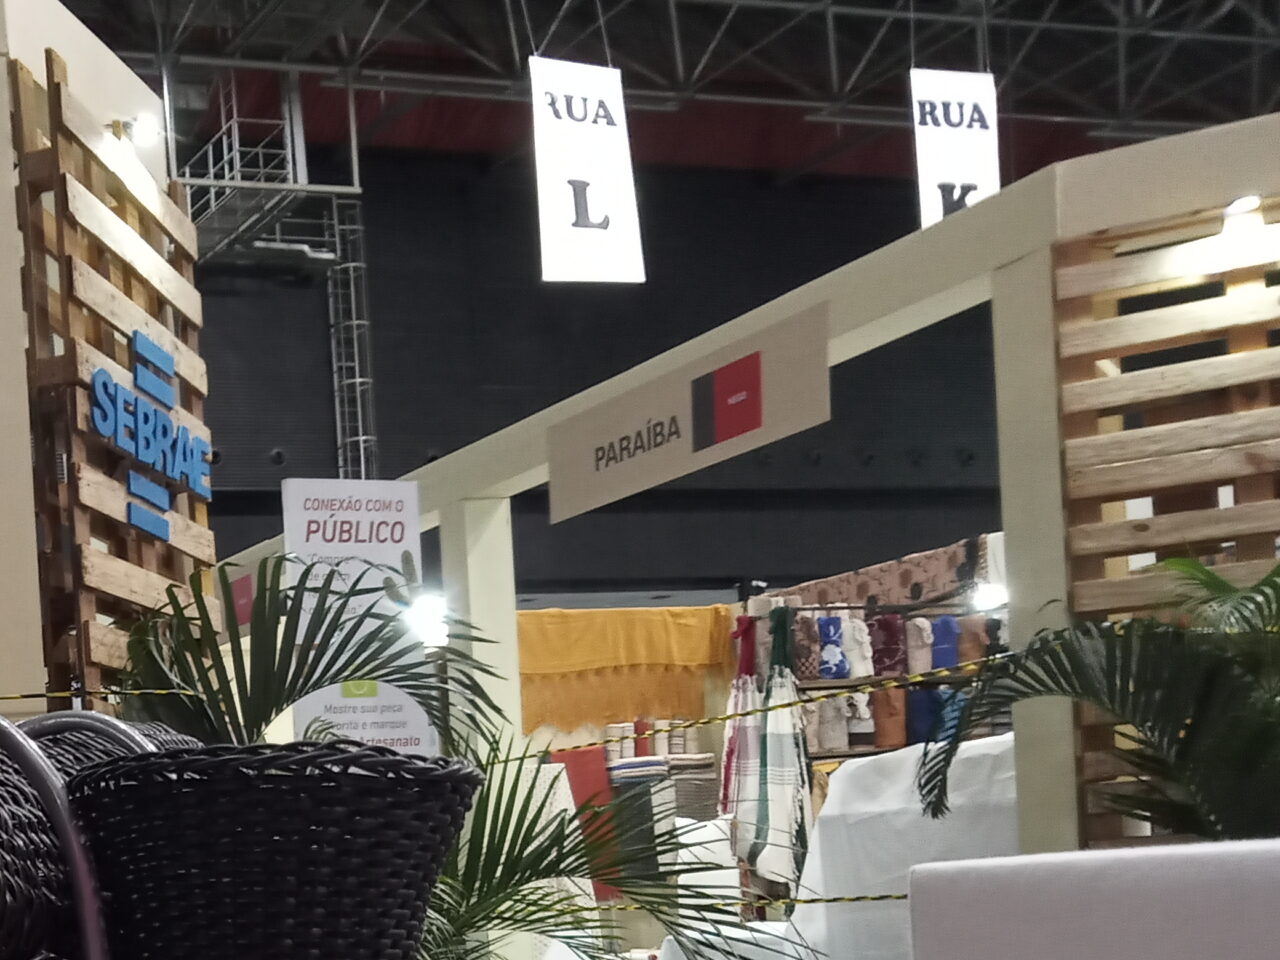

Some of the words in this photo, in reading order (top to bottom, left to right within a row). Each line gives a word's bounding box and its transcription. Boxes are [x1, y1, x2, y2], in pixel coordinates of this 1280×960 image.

[916, 99, 990, 130] RUA
[566, 179, 610, 230] L
[92, 367, 213, 502] SEBRAE
[594, 415, 682, 472] PARAÍBA
[303, 495, 362, 512] CONEXÃO
[365, 499, 392, 513] COM
[394, 499, 405, 513] O
[304, 513, 406, 544] PÚBLICO
[323, 704, 359, 715] Mostre
[360, 705, 379, 714] sua
[370, 720, 408, 731] marque
